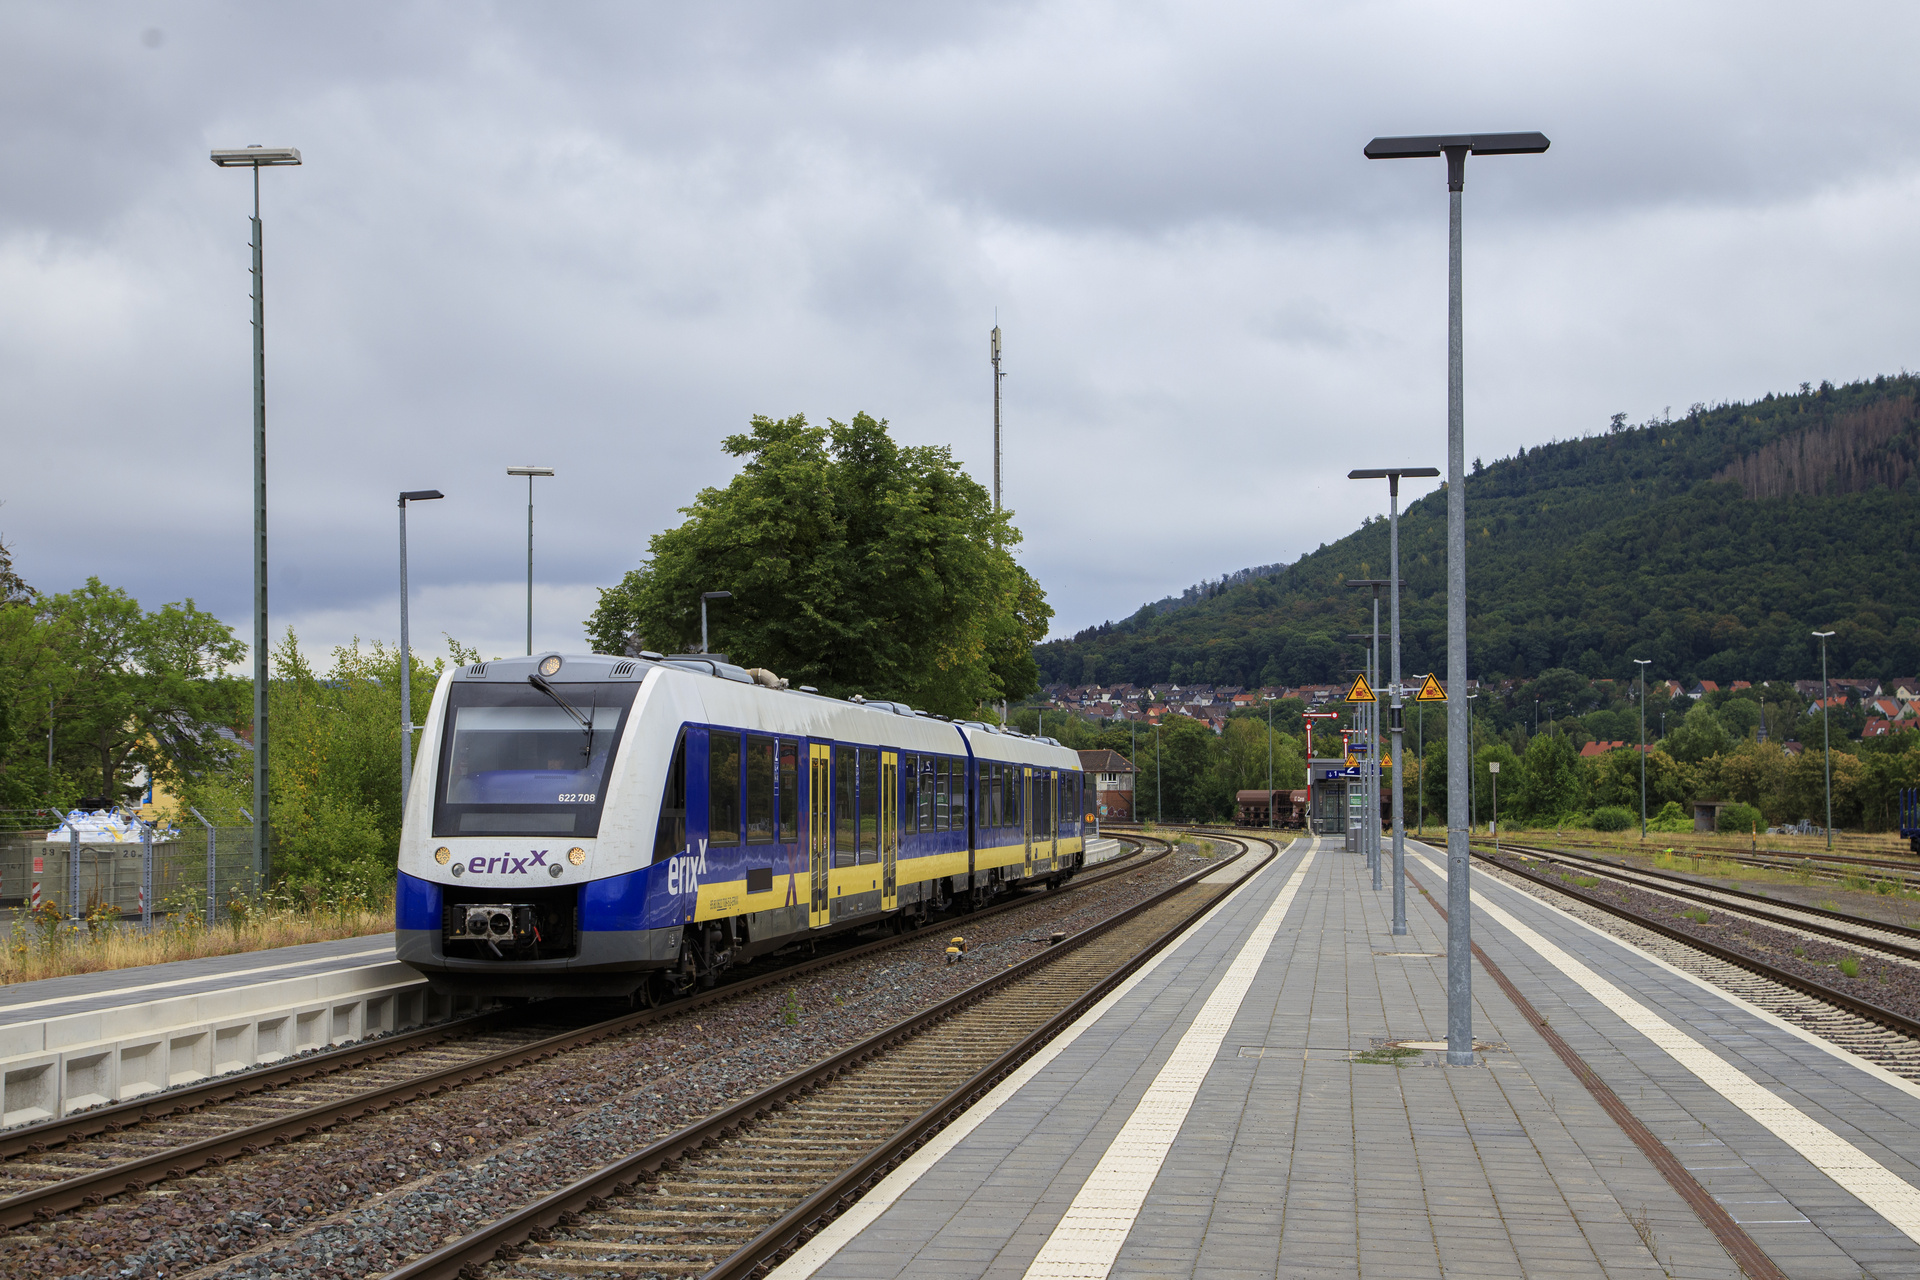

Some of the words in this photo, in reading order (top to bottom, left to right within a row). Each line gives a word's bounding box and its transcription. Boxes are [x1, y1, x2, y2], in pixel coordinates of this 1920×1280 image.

[558, 794, 576, 802] 622
[578, 794, 596, 802] 708
[468, 850, 549, 874] erixx
